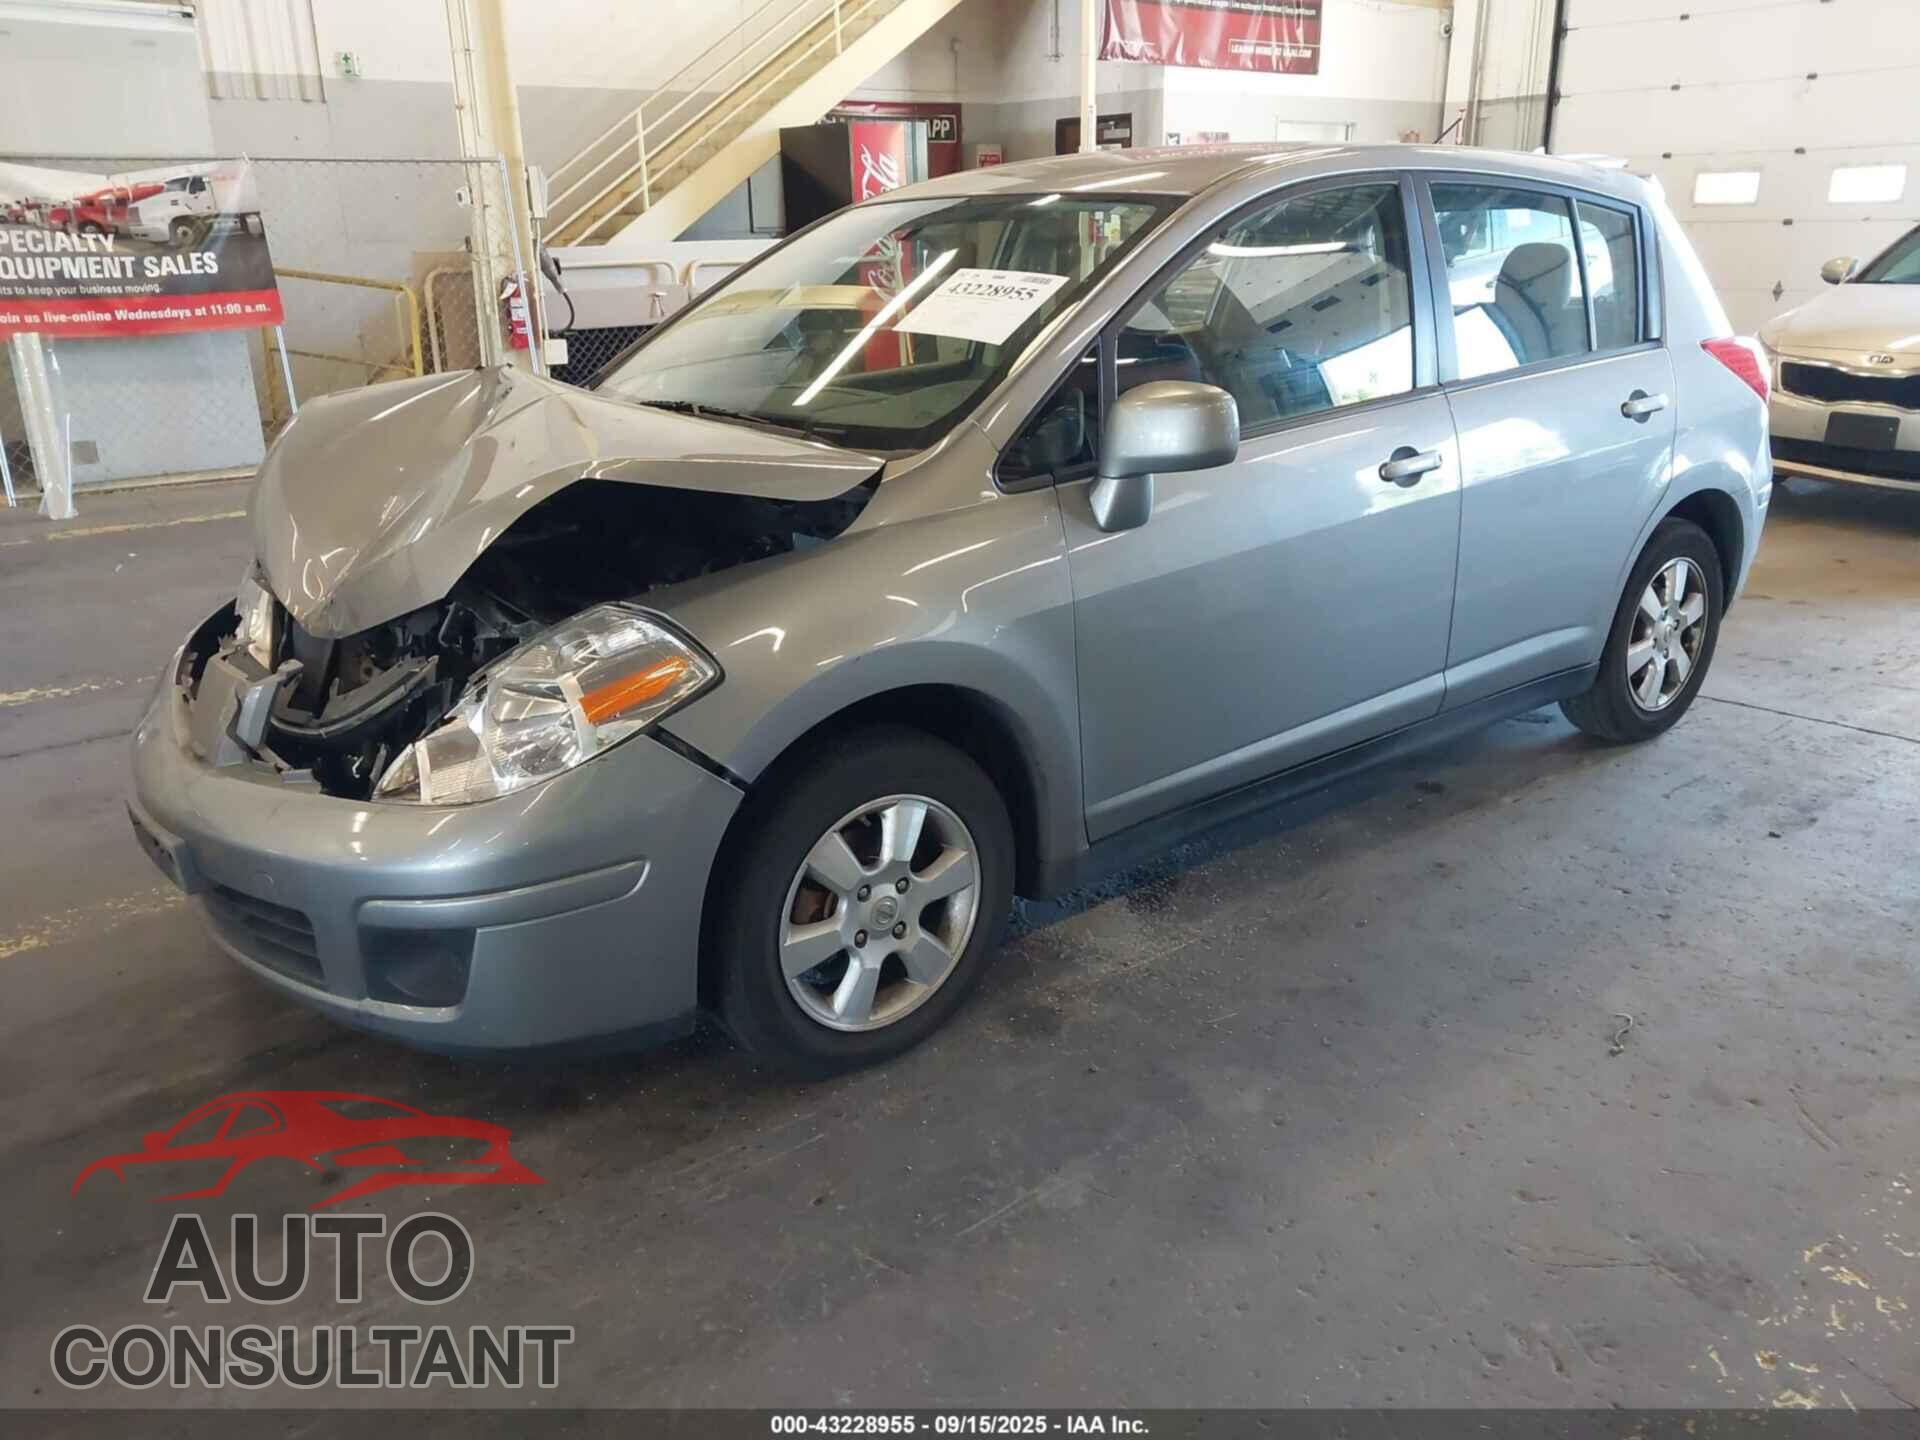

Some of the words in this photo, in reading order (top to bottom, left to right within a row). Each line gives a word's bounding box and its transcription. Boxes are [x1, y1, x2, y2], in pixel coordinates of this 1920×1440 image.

[0, 255, 136, 279] QUIPMENT
[143, 251, 219, 278] SALES
[15, 286, 26, 295] to
[27, 284, 54, 296] keep
[55, 285, 77, 297] your
[79, 283, 123, 295] business
[949, 281, 1040, 301] 43228955
[24, 313, 41, 323] us
[43, 310, 112, 323] live-online
[114, 307, 192, 321] Wednesdays
[195, 306, 208, 317] at
[210, 303, 242, 315] 11:00
[244, 303, 271, 314] a.m.
